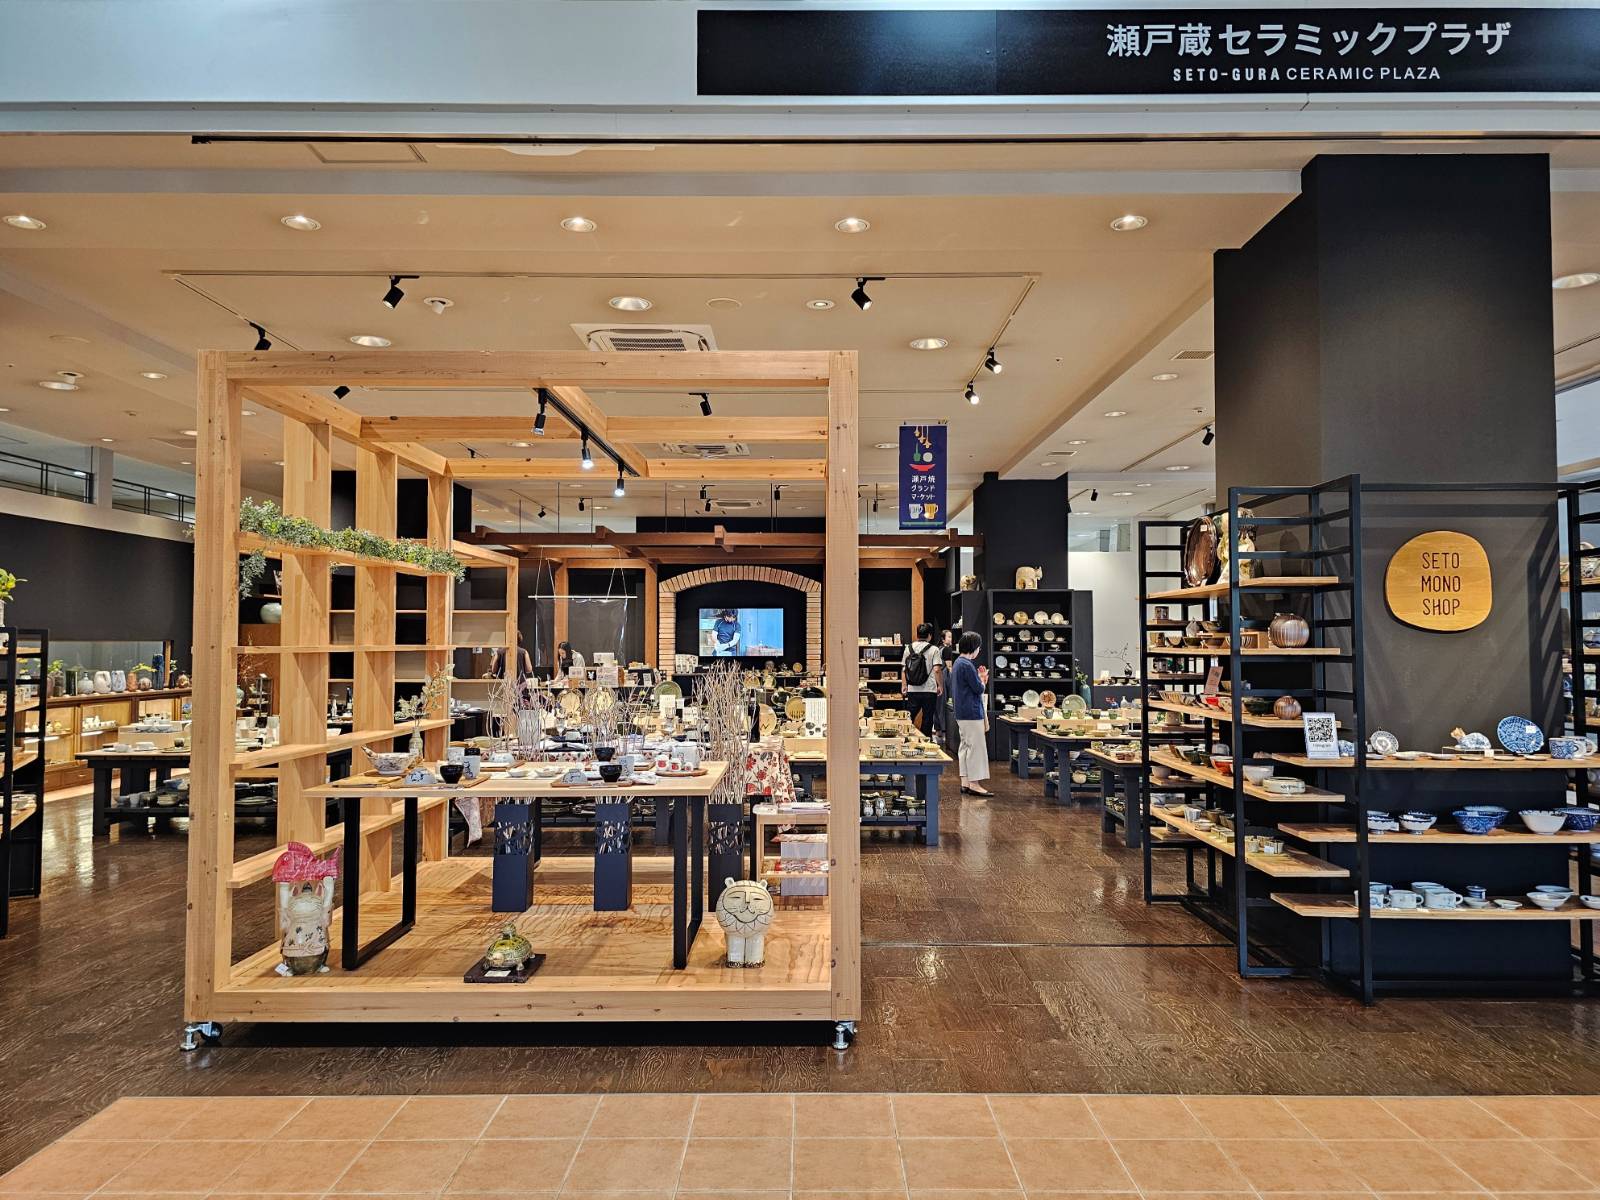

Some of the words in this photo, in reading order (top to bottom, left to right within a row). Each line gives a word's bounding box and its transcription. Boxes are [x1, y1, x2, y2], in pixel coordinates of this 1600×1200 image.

[1106, 22, 1511, 57] 瀬戸蔵セラミックプラザ
[1173, 68, 1280, 82] SETO-GURA
[1286, 67, 1374, 81] CERAMIC
[1380, 67, 1441, 81] PLAZA
[911, 475, 936, 483] 瀬戸焼
[911, 484, 936, 492] グランド
[1422, 552, 1460, 569] SETO
[1421, 575, 1461, 592] MONO
[1422, 598, 1460, 615] SHOP
